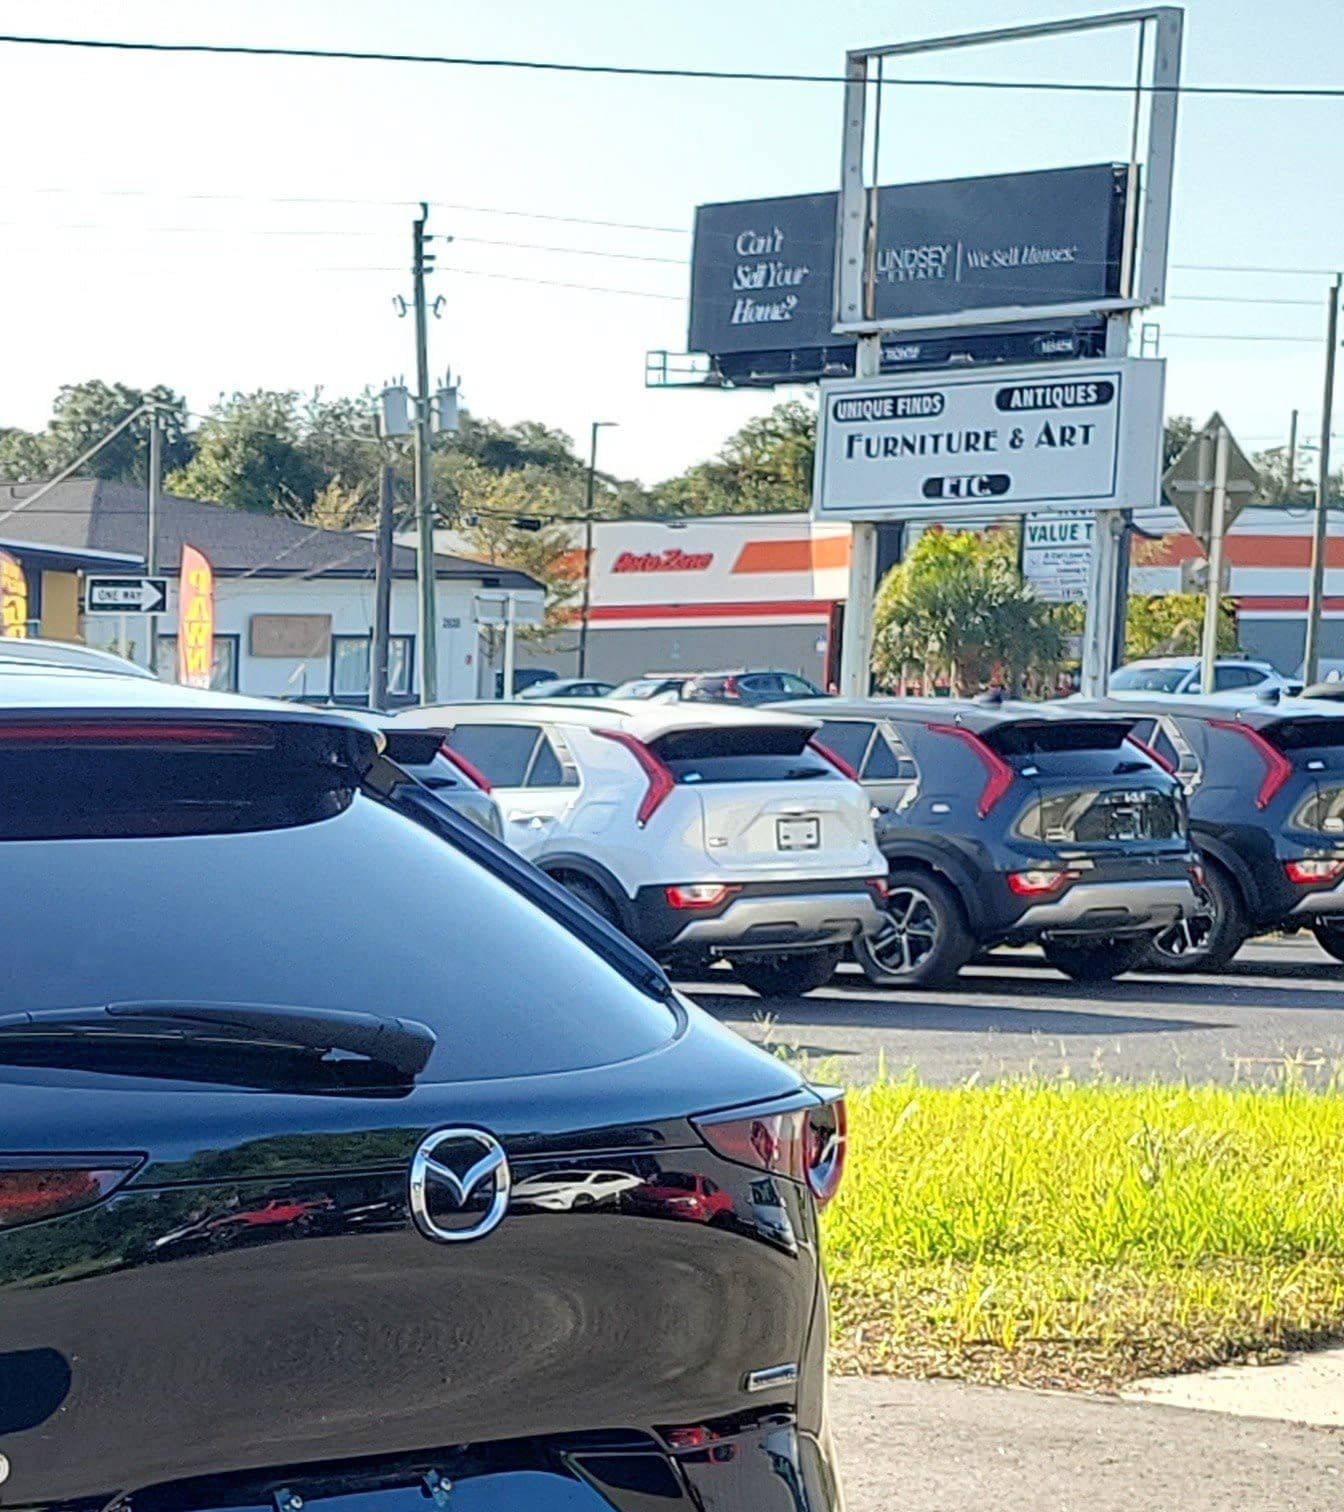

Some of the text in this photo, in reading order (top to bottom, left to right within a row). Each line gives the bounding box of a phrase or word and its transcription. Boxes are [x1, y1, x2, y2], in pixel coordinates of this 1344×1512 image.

[735, 226, 784, 256] Can't
[876, 246, 948, 272] LINDSEY
[732, 262, 810, 290] Sell Your
[730, 295, 798, 324] Home?
[836, 384, 1099, 422] UNIQUE FINDS ANTIQUES
[845, 419, 1097, 459] FURNITURE & ART
[941, 475, 992, 498] ETC
[1028, 523, 1079, 542] VALUE
[611, 548, 714, 573] AutoZone
[97, 589, 142, 601] ONE WAY
[184, 569, 210, 674] PAWN
